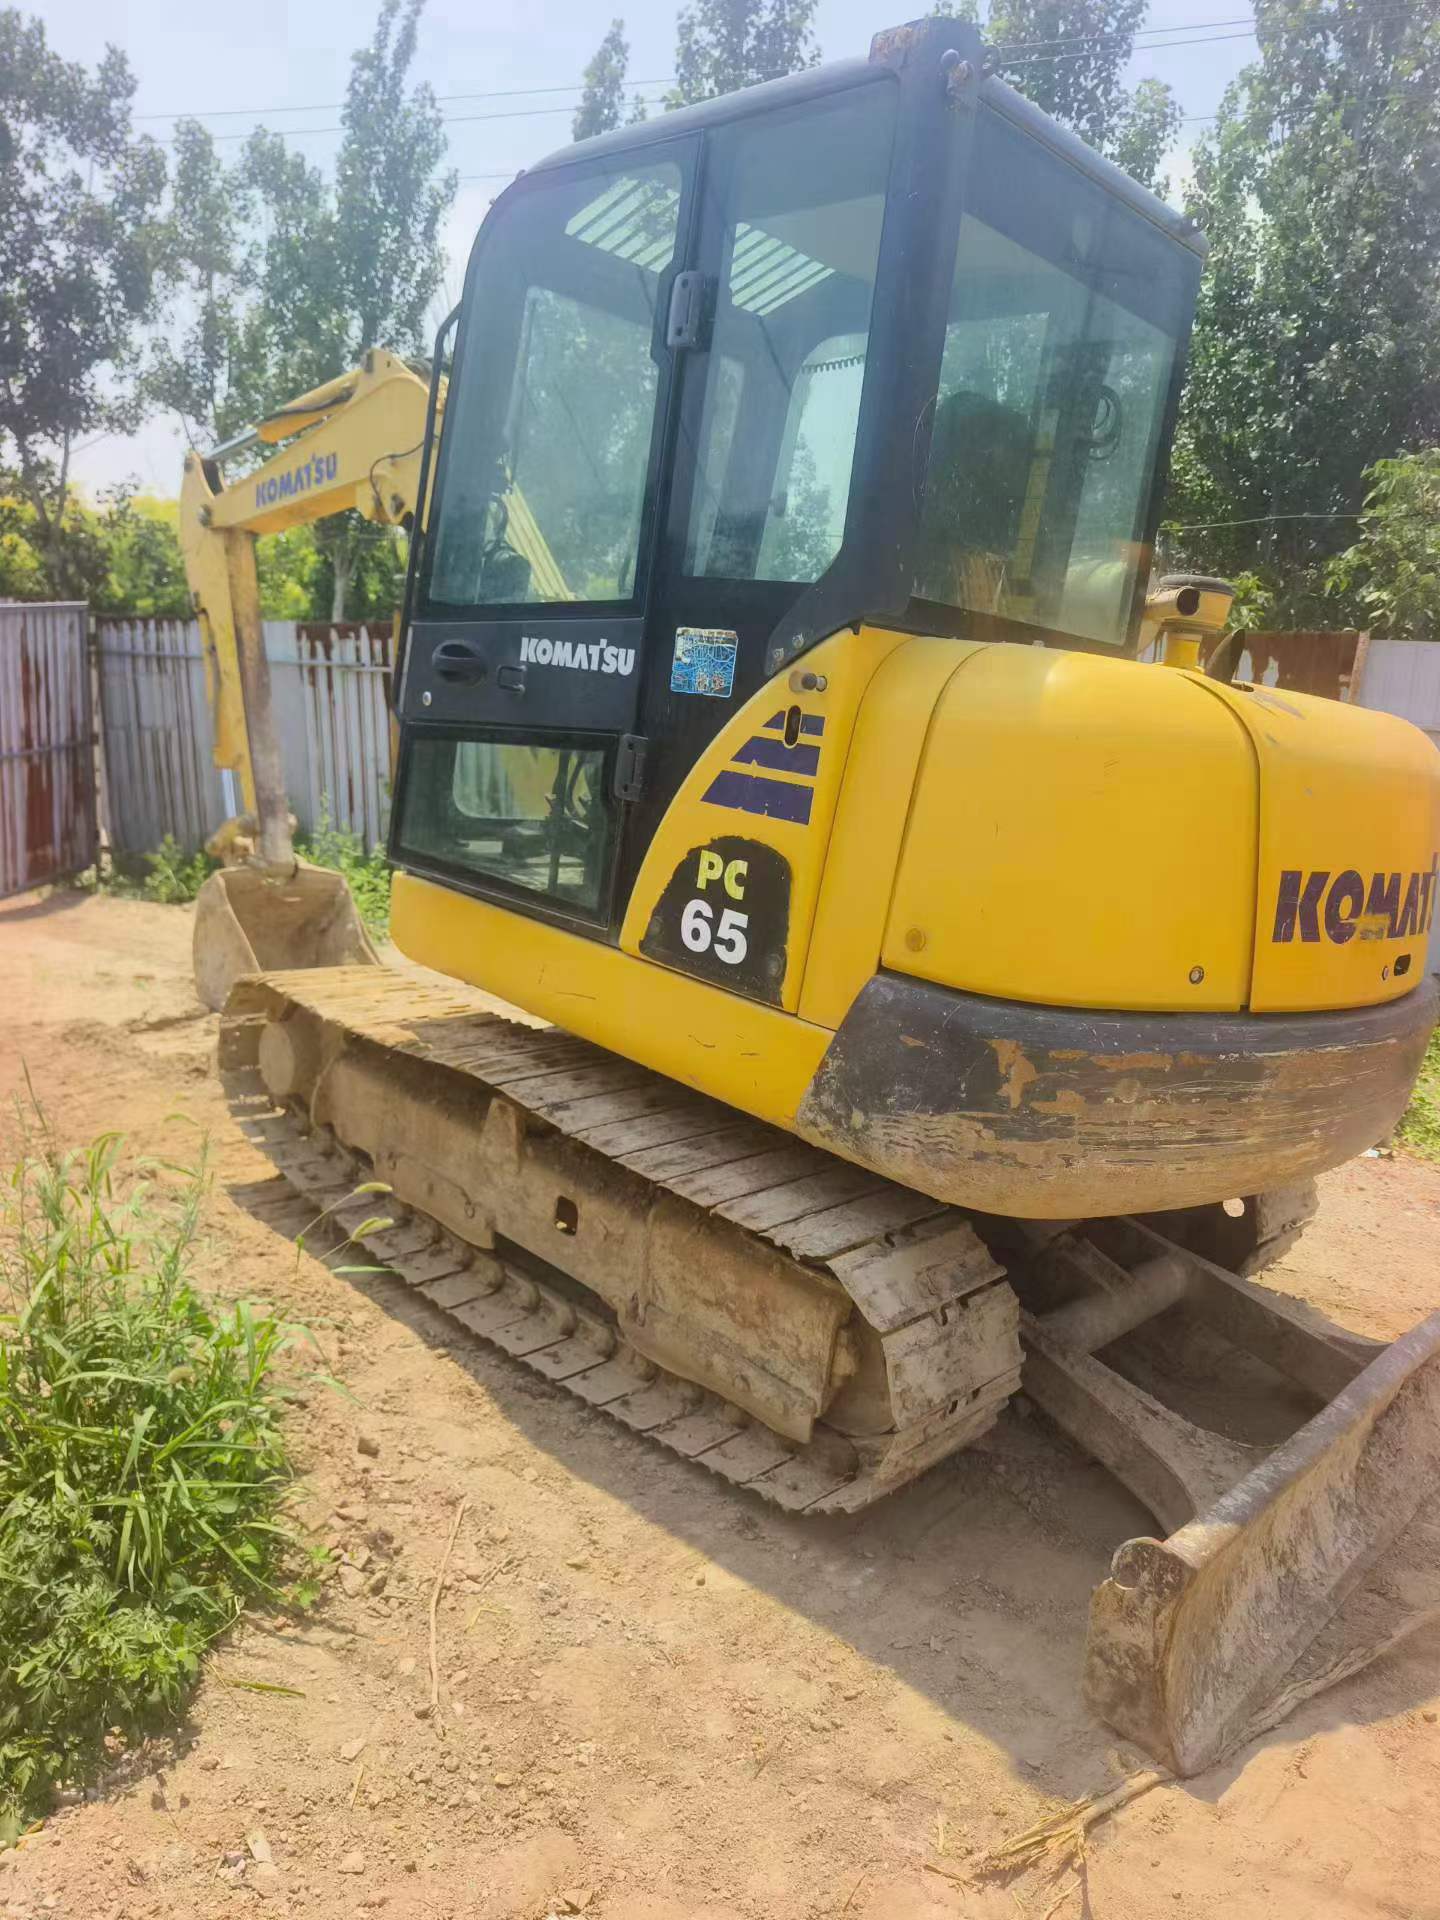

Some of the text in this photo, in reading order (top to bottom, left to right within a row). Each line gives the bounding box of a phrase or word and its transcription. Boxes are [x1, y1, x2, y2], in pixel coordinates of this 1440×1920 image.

[255, 452, 337, 508] KOMATSU
[520, 636, 636, 676] KOMATSU
[696, 849, 749, 901] PC
[1272, 853, 1438, 944] KOMAT
[680, 898, 749, 965] 65
